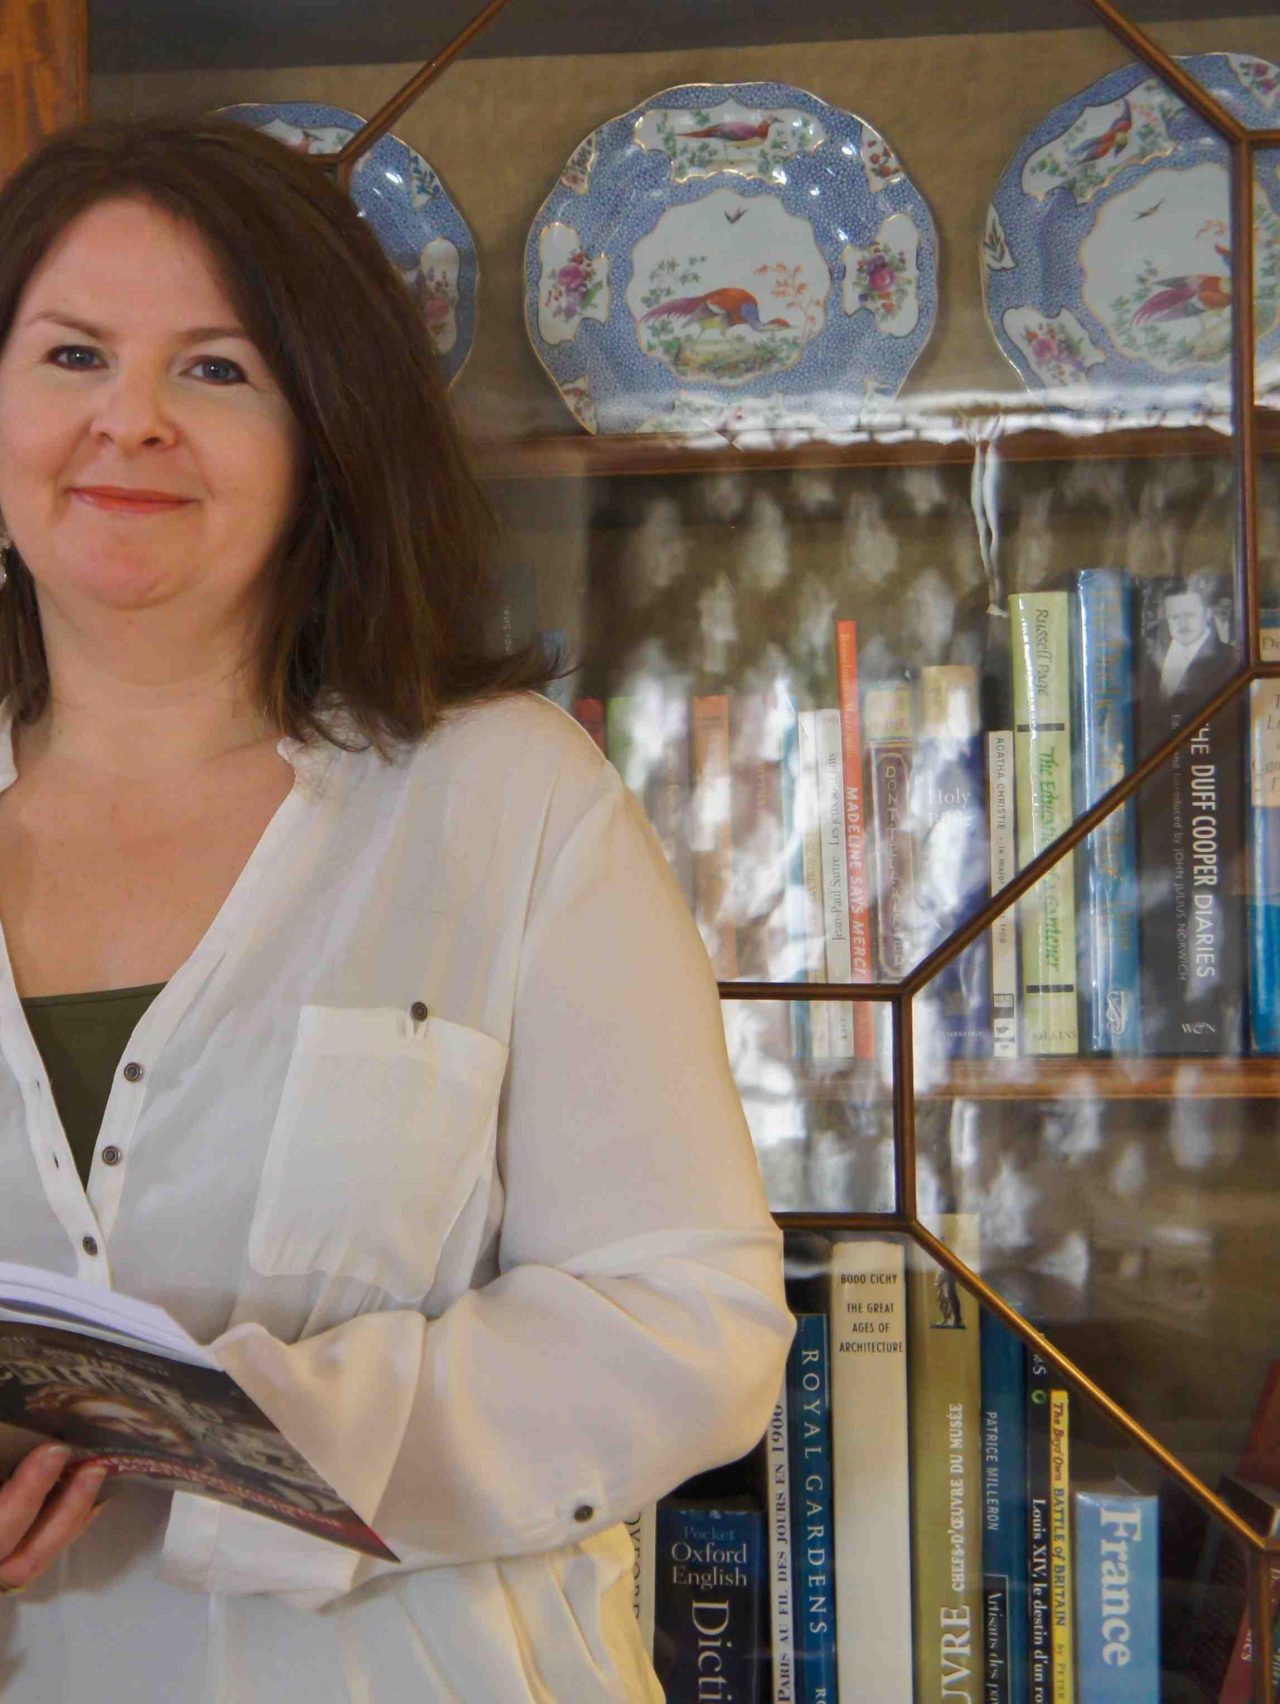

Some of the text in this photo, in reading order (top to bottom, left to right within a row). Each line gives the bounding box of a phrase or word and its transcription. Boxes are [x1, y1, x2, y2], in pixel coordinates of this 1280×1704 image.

[1035, 608, 1053, 697] Russell Page
[996, 737, 1006, 780] AGATHA
[1041, 746, 1057, 776] The
[928, 787, 972, 810] Holy
[996, 783, 1007, 831] CHRISTIE
[1173, 849, 1185, 880] JOHN
[1190, 724, 1218, 978] HE DUFF COOPER DIARIES
[847, 787, 868, 978] MADELINE SAYS MERCI
[1174, 882, 1186, 919] JULIUS
[832, 884, 845, 941] Jean-Paul
[1176, 922, 1188, 981] NORWICH
[840, 1273, 898, 1285] BODO CICHY
[847, 1302, 894, 1313] THE GREAT
[852, 1322, 890, 1333] AGES OF
[839, 1341, 903, 1353] ARCHITECTURE
[802, 1350, 823, 1459] ROYAL
[1053, 1403, 1064, 1425] The
[945, 1403, 963, 1449] MUSÉE
[949, 1454, 964, 1474] DU
[985, 1411, 999, 1531] PATRICE MILLERON
[1053, 1457, 1064, 1481] Own
[684, 1526, 737, 1540] Pocket
[1032, 1499, 1047, 1539] Louis
[1053, 1488, 1065, 1541] BATTLE
[671, 1541, 748, 1564] Oxford
[771, 1405, 791, 1704] PARIS AU FIL DES JOURS EN 1900
[805, 1475, 827, 1633] GARDENS
[1031, 1546, 1048, 1578] XIV,
[1051, 1547, 1065, 1561] of
[672, 1565, 748, 1591] English
[1032, 1583, 1048, 1596] le
[1053, 1565, 1066, 1626] BRITAIN
[1100, 1507, 1142, 1667] France
[987, 1593, 1003, 1649] Artisans
[1033, 1600, 1048, 1645] destin
[692, 1600, 734, 1704] Dicti
[988, 1653, 1004, 1680] des
[1033, 1650, 1050, 1682] d'un
